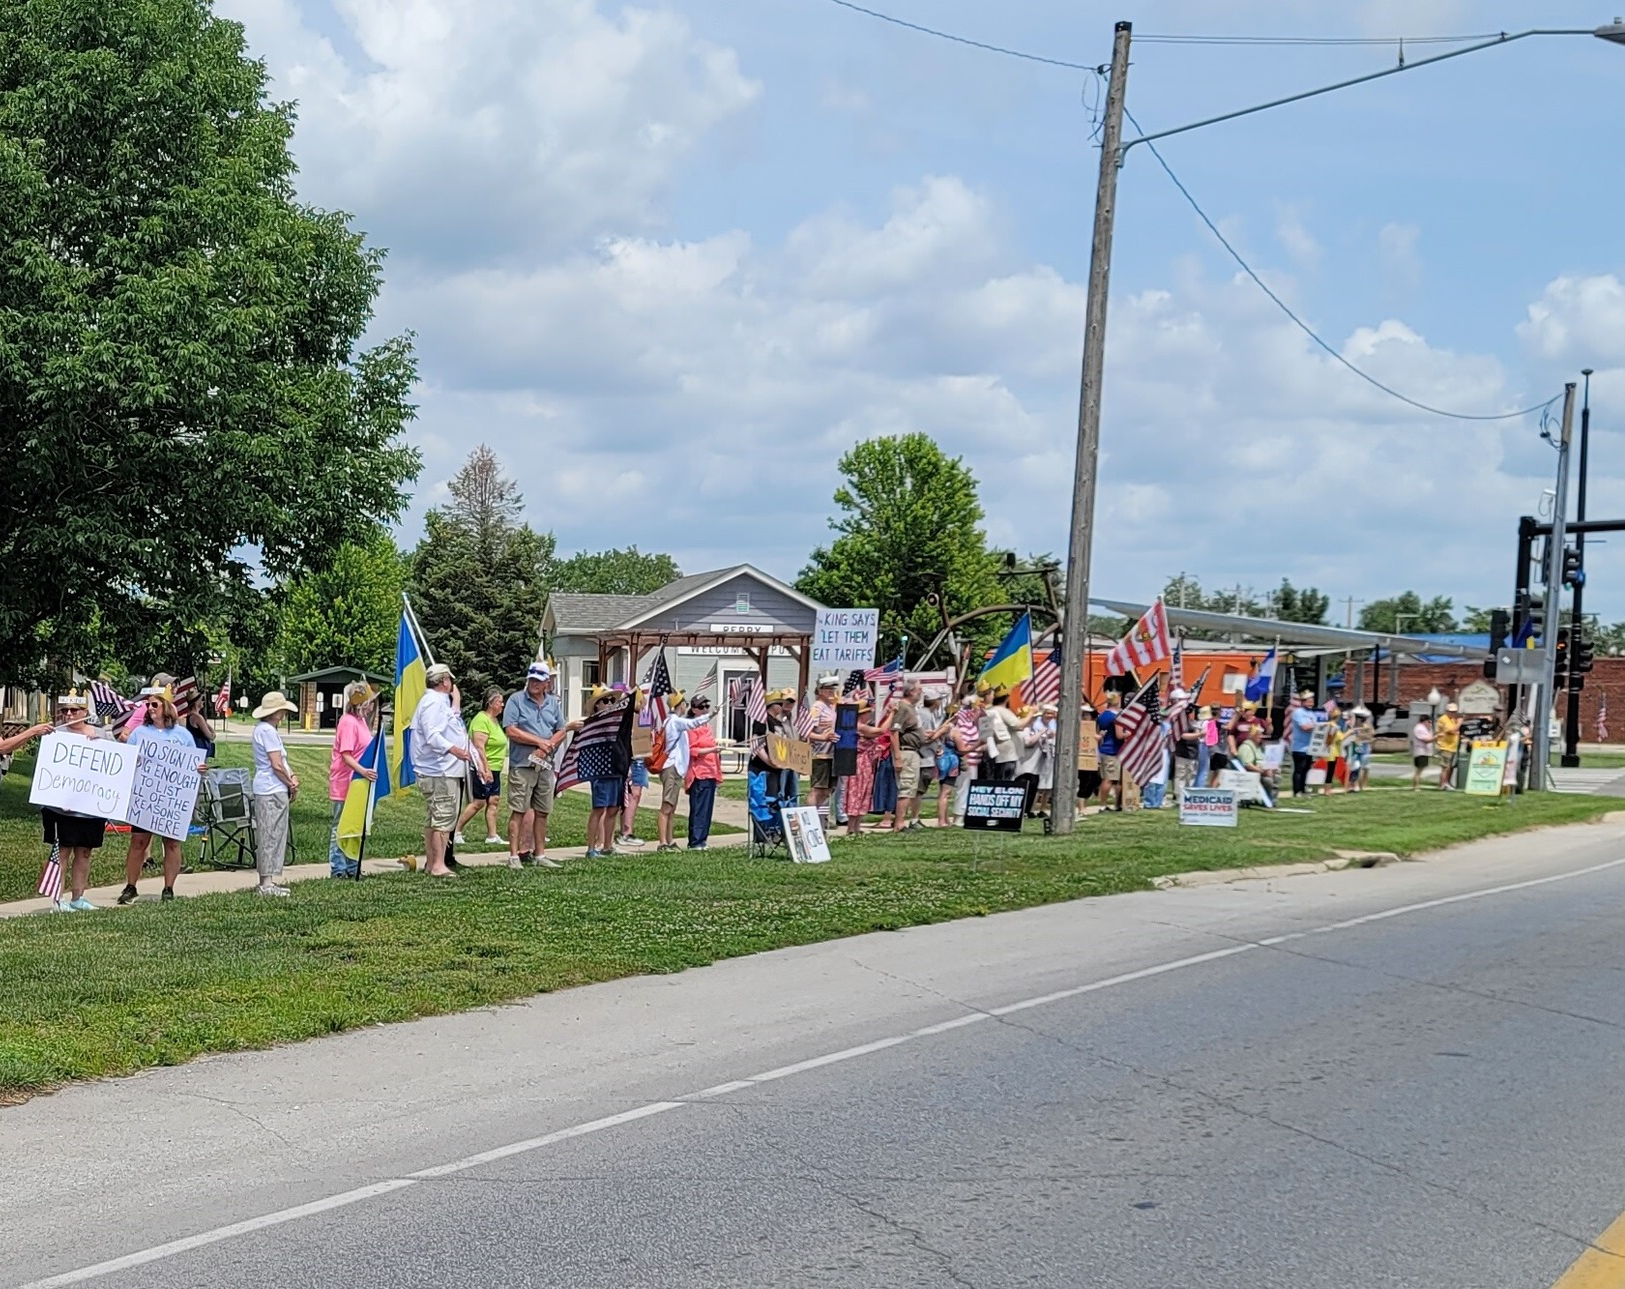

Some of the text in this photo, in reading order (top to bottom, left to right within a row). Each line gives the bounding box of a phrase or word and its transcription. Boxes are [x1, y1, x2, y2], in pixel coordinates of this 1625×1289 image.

[824, 612, 848, 626] KING
[852, 613, 876, 627] SAYS
[844, 630, 869, 644] THEM
[813, 647, 830, 661] EAT
[53, 742, 123, 776] DEFEND
[139, 738, 158, 758] NO
[158, 746, 187, 769] SIGN
[186, 754, 200, 772] IS
[141, 774, 182, 798] TO LIST
[154, 764, 199, 790] ENOUGH
[38, 767, 120, 814] Democracy
[971, 785, 994, 794] HEY
[134, 796, 181, 822] REASONS
[149, 792, 166, 806] OF
[169, 797, 189, 812] THE
[969, 793, 996, 807] HANDS
[995, 794, 1010, 807] OFF
[1183, 795, 1233, 805] MEDICAID
[967, 806, 1022, 819] SOCIAL SECURITY
[150, 815, 181, 837] HERE
